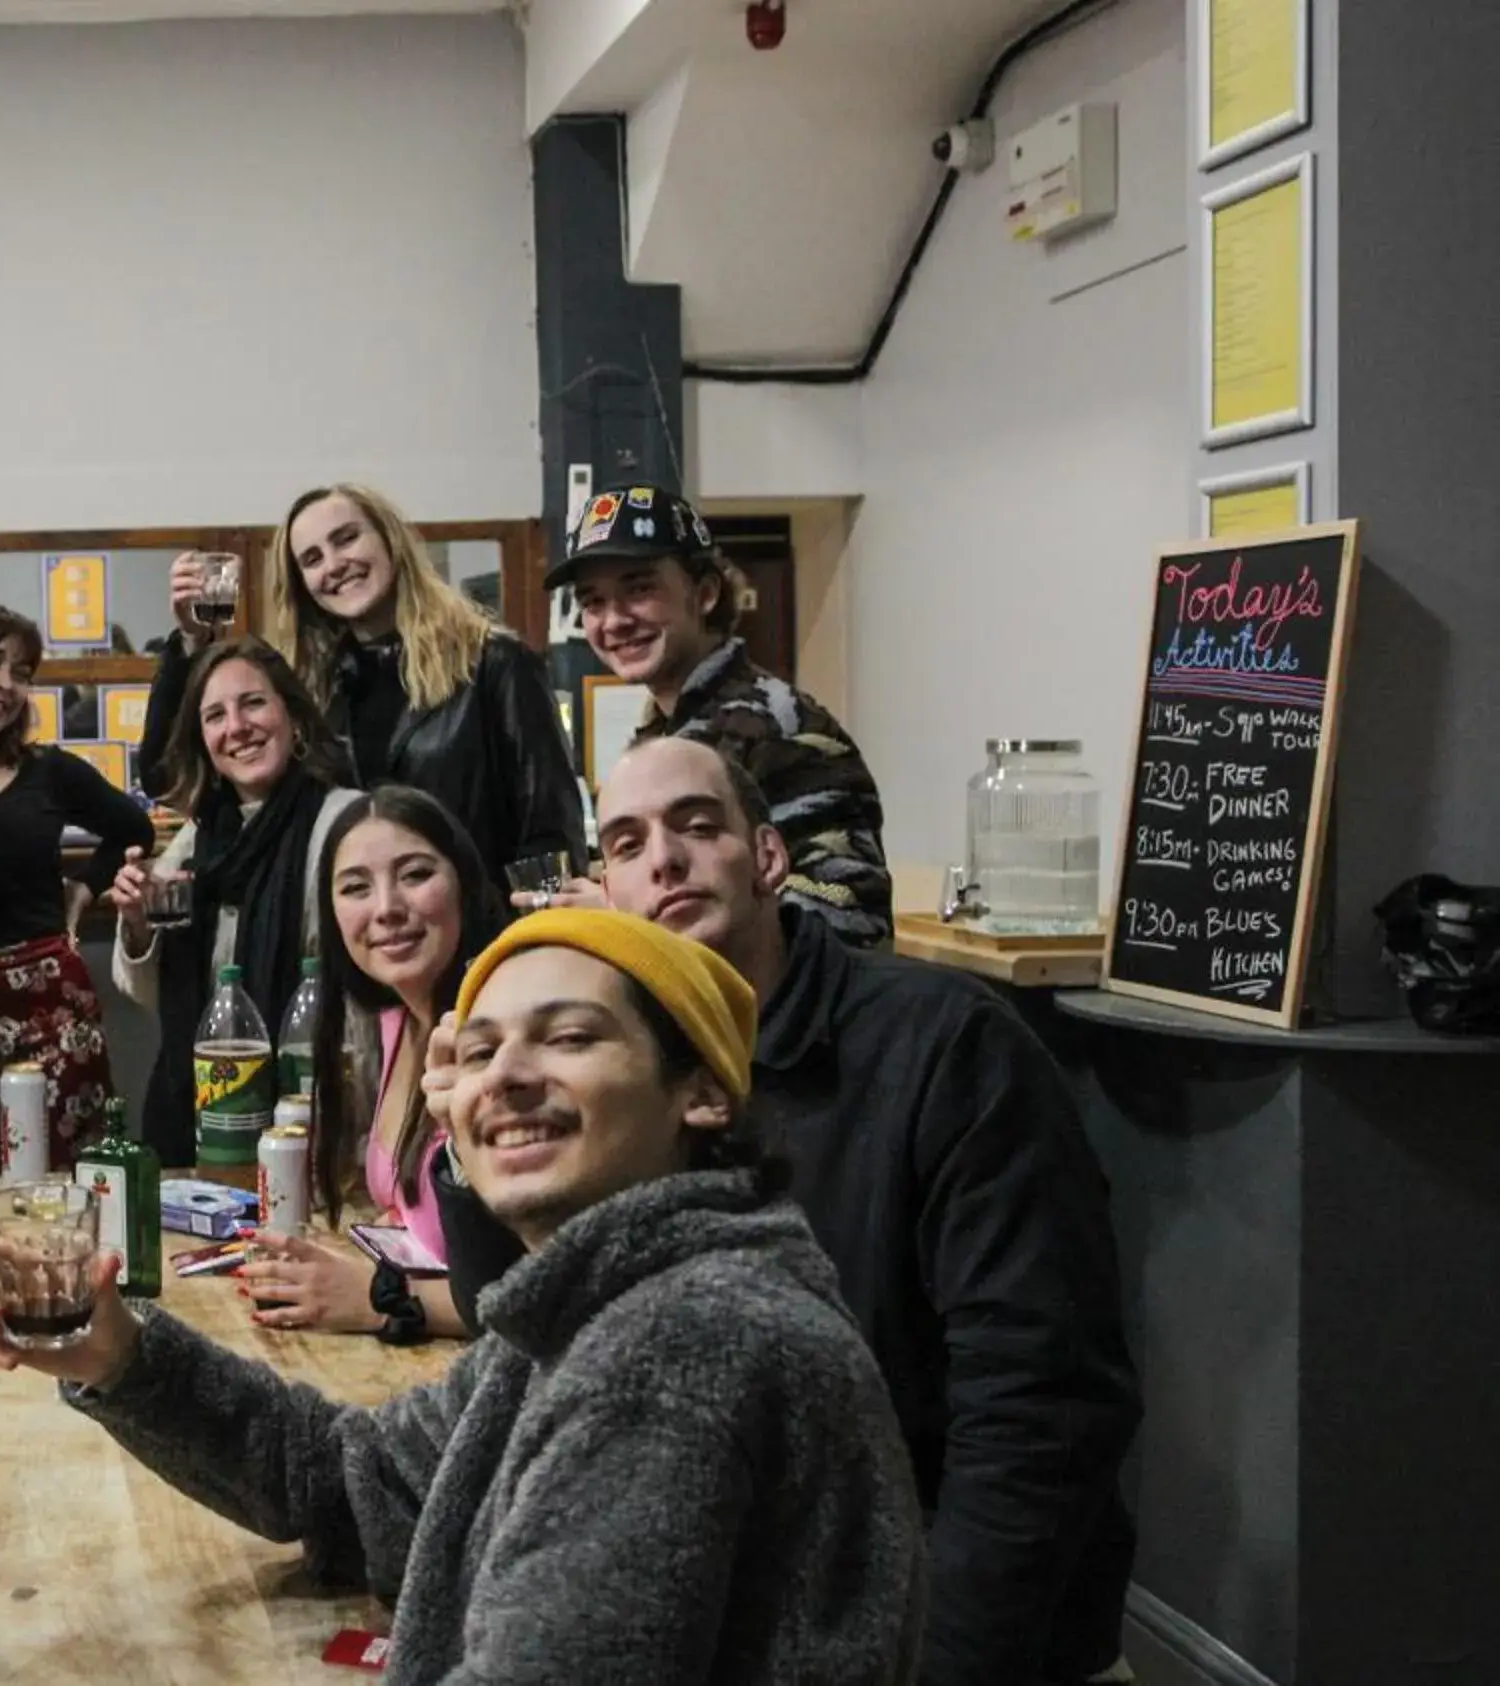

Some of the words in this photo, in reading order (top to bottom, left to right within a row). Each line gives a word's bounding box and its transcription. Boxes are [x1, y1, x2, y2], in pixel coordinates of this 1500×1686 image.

[1163, 556, 1323, 651] Today's
[1154, 621, 1299, 675] Activities
[1206, 761, 1267, 790] FREE
[1208, 788, 1290, 826] DINNER
[1207, 837, 1297, 865] DRINKING
[1210, 947, 1284, 981] KITCHEN
